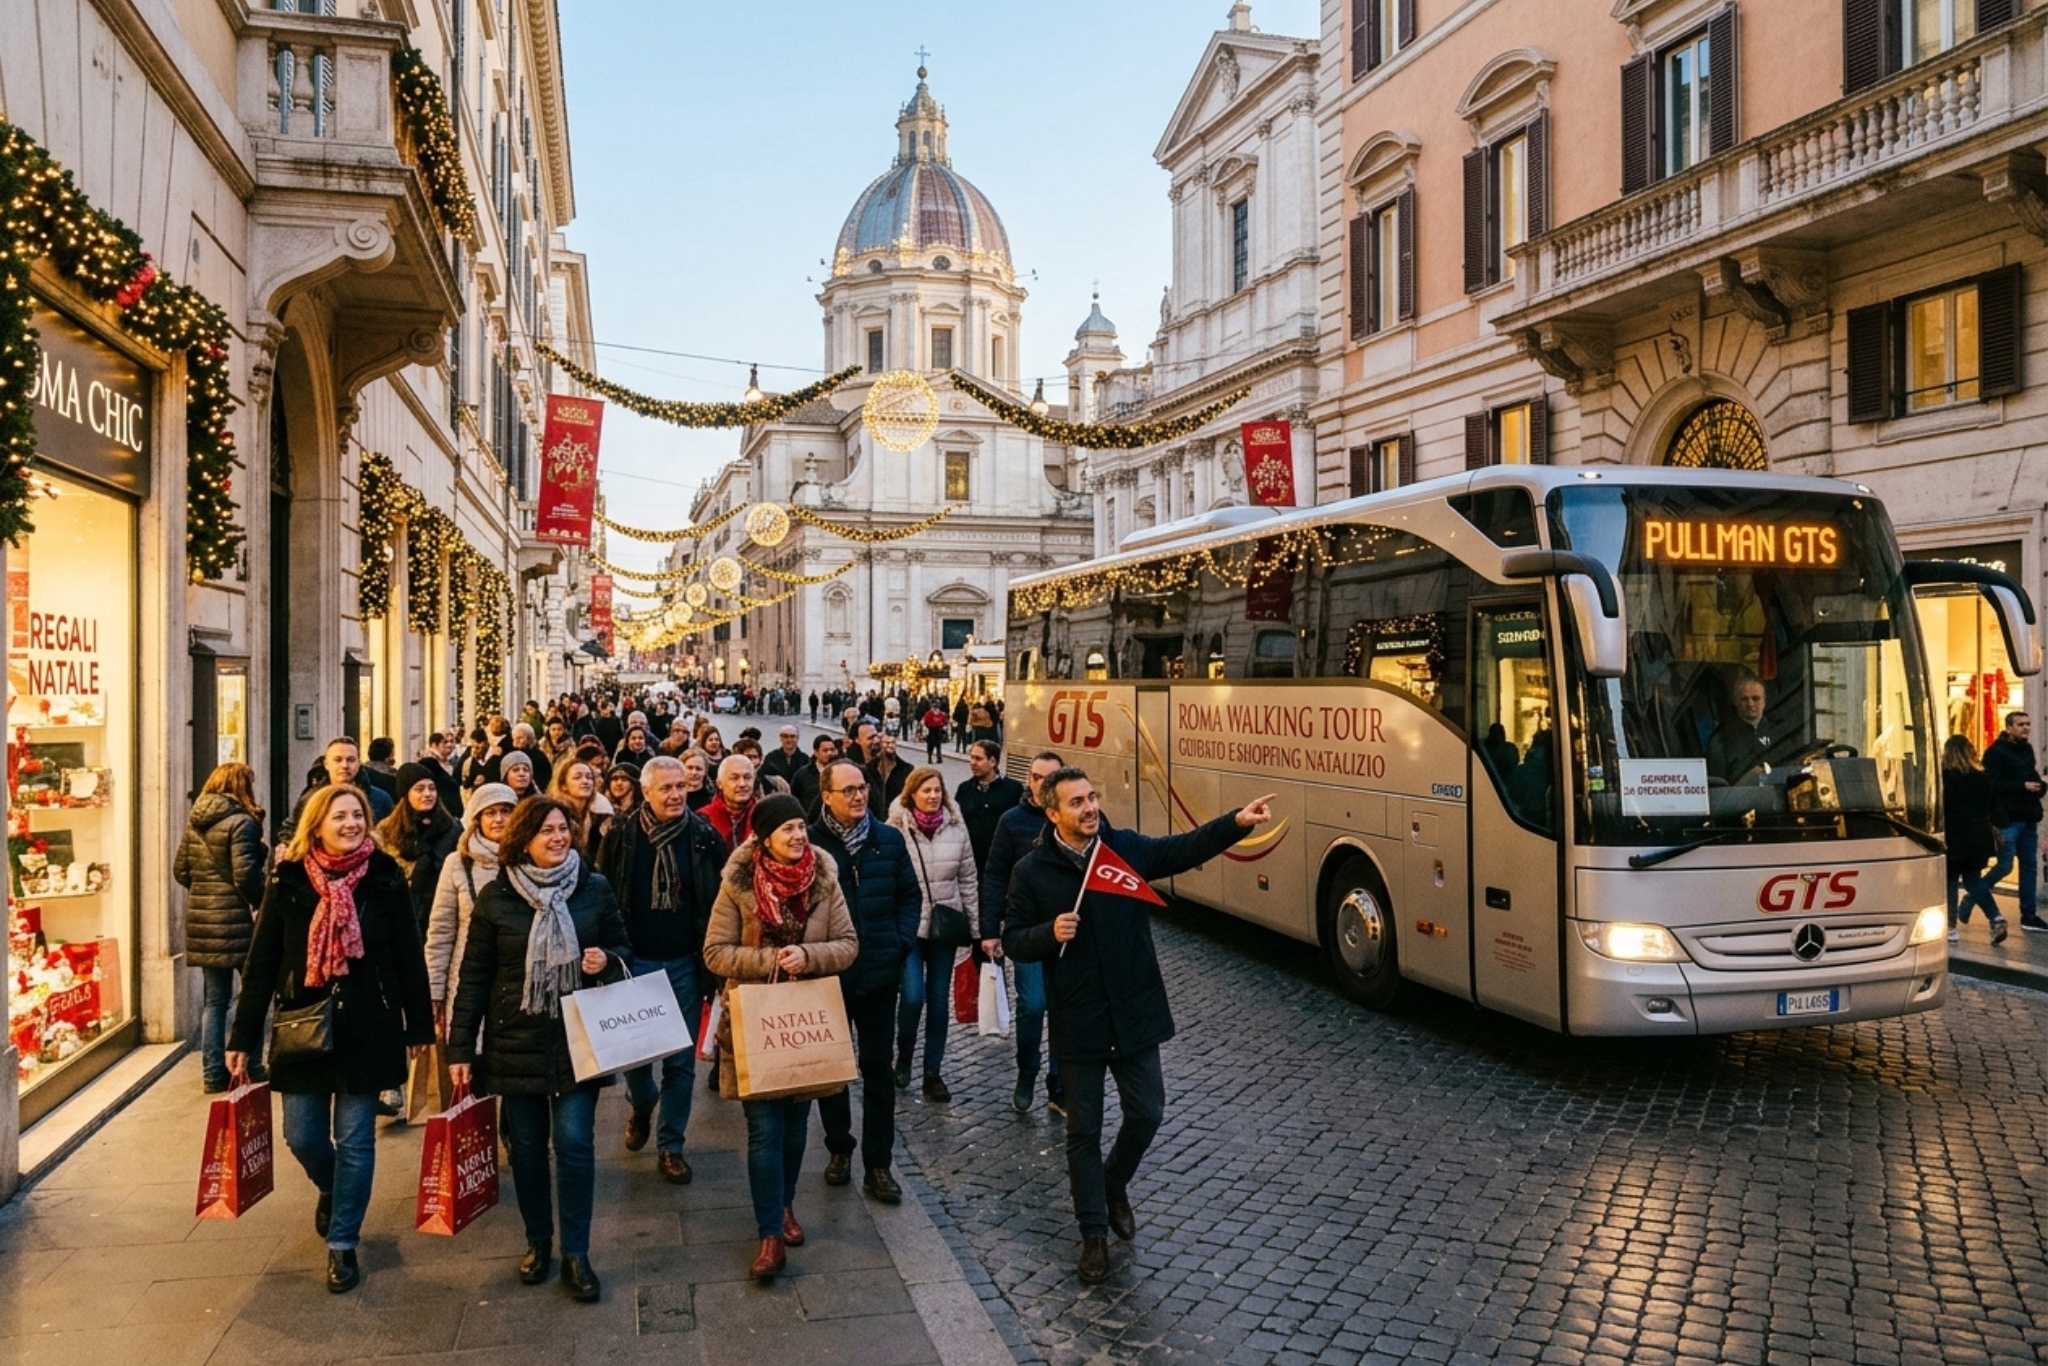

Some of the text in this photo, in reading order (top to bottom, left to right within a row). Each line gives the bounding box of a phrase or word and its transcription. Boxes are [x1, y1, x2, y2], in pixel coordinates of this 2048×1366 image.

[87, 380, 143, 453] CHIC
[1645, 521, 1838, 564] PULLMAN GTS
[30, 611, 97, 654] REGALI
[29, 659, 99, 696] NATALE
[1048, 690, 1108, 748] GTS
[1178, 703, 1387, 743] ROMA WALKING TOUR
[1228, 742, 1236, 762] E
[1096, 863, 1140, 892] GTS
[1757, 870, 1859, 913] GTS
[763, 1027, 835, 1050] A ROMA
